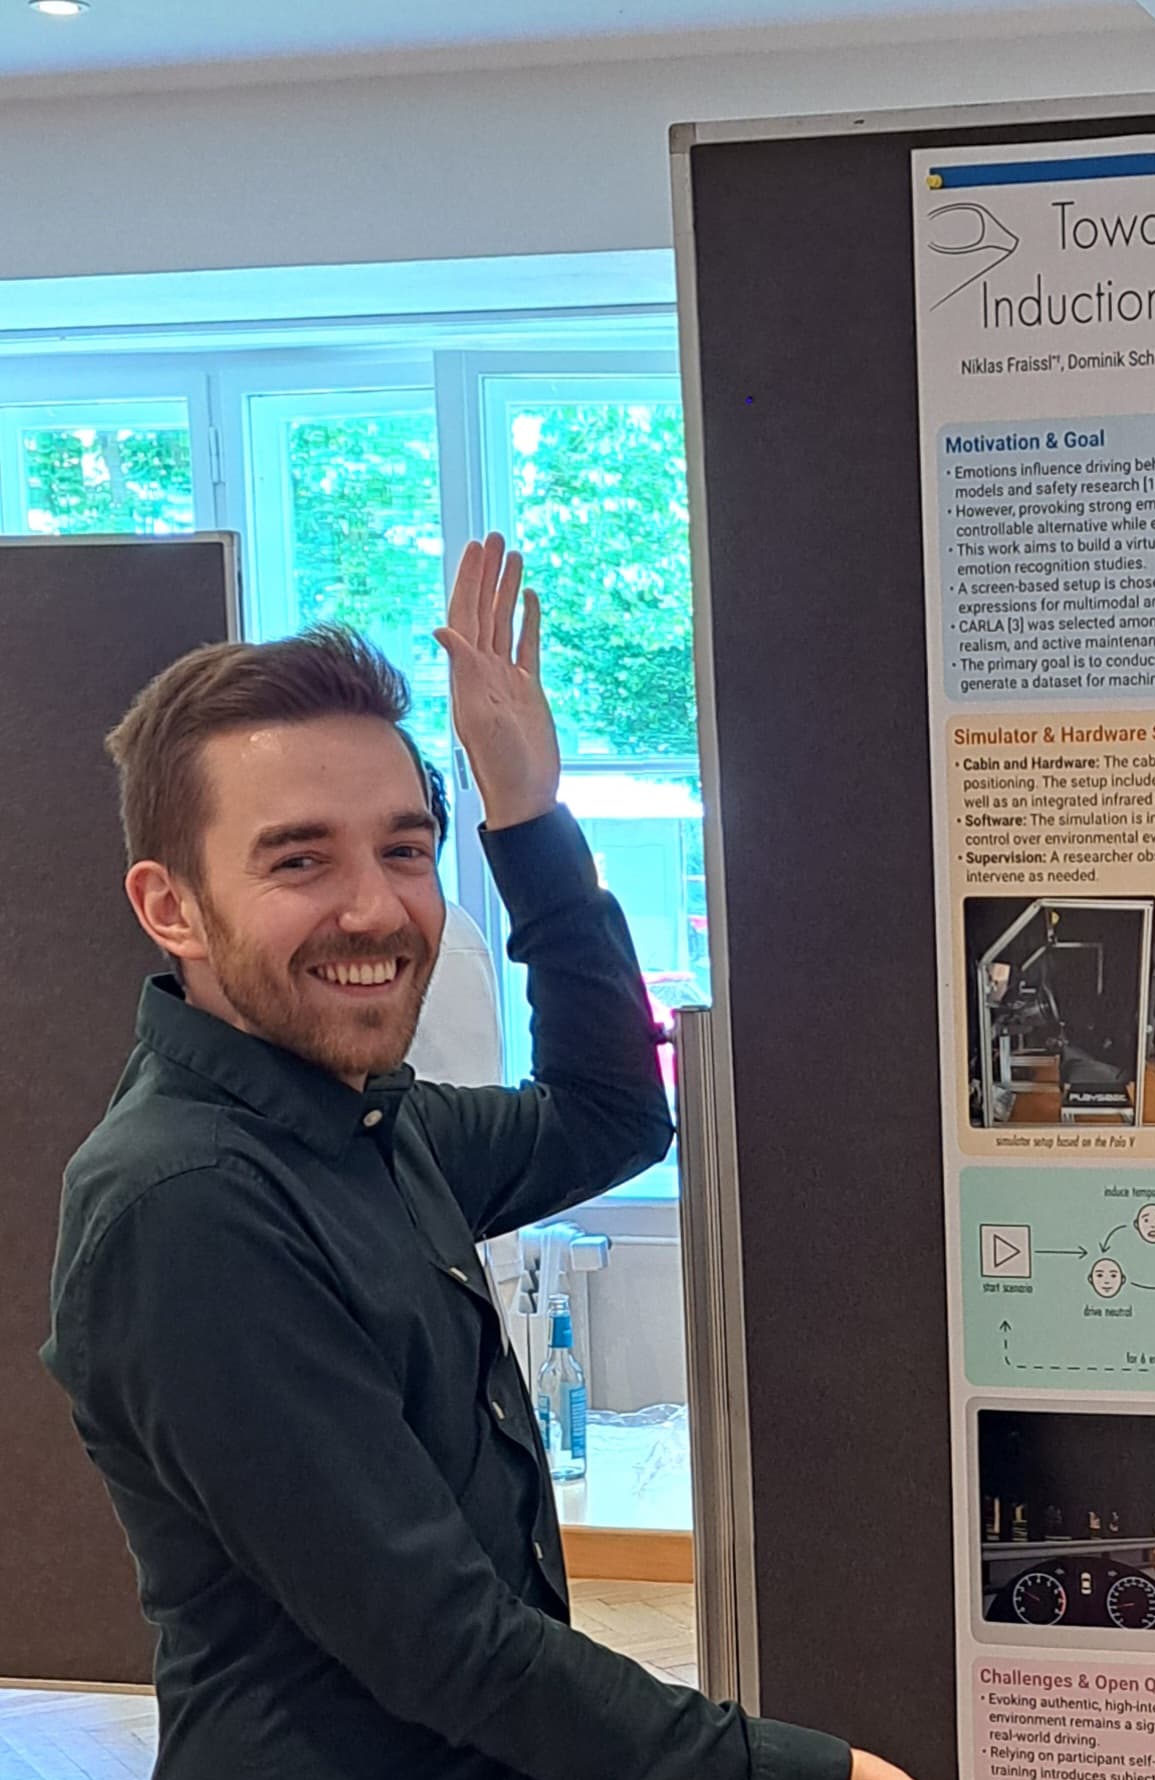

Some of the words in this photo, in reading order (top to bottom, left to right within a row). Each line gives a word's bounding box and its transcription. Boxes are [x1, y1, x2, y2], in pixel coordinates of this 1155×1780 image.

[961, 357, 1003, 375] Niklas
[1067, 350, 1125, 370] Dominik
[945, 433, 1040, 454] Motivation
[1045, 431, 1058, 449] &
[1063, 428, 1104, 448] Goal
[954, 463, 1017, 479] Emotions
[1020, 461, 1082, 476] influence
[1085, 458, 1131, 476] driving
[955, 483, 1004, 498] models
[1007, 481, 1032, 496] and
[1035, 480, 1077, 497] safety
[1080, 477, 1140, 493] research
[954, 727, 1038, 745] Simulator
[1043, 726, 1055, 743] &
[1061, 724, 1147, 743] Hardware
[980, 1668, 1073, 1691] Challenges
[1077, 1673, 1090, 1689] &
[1094, 1674, 1139, 1694] Open
[988, 1692, 1037, 1710] Evoking
[1039, 1696, 1102, 1712] authentic,
[989, 1728, 1051, 1744] real-world
[1053, 1731, 1100, 1749] driving.
